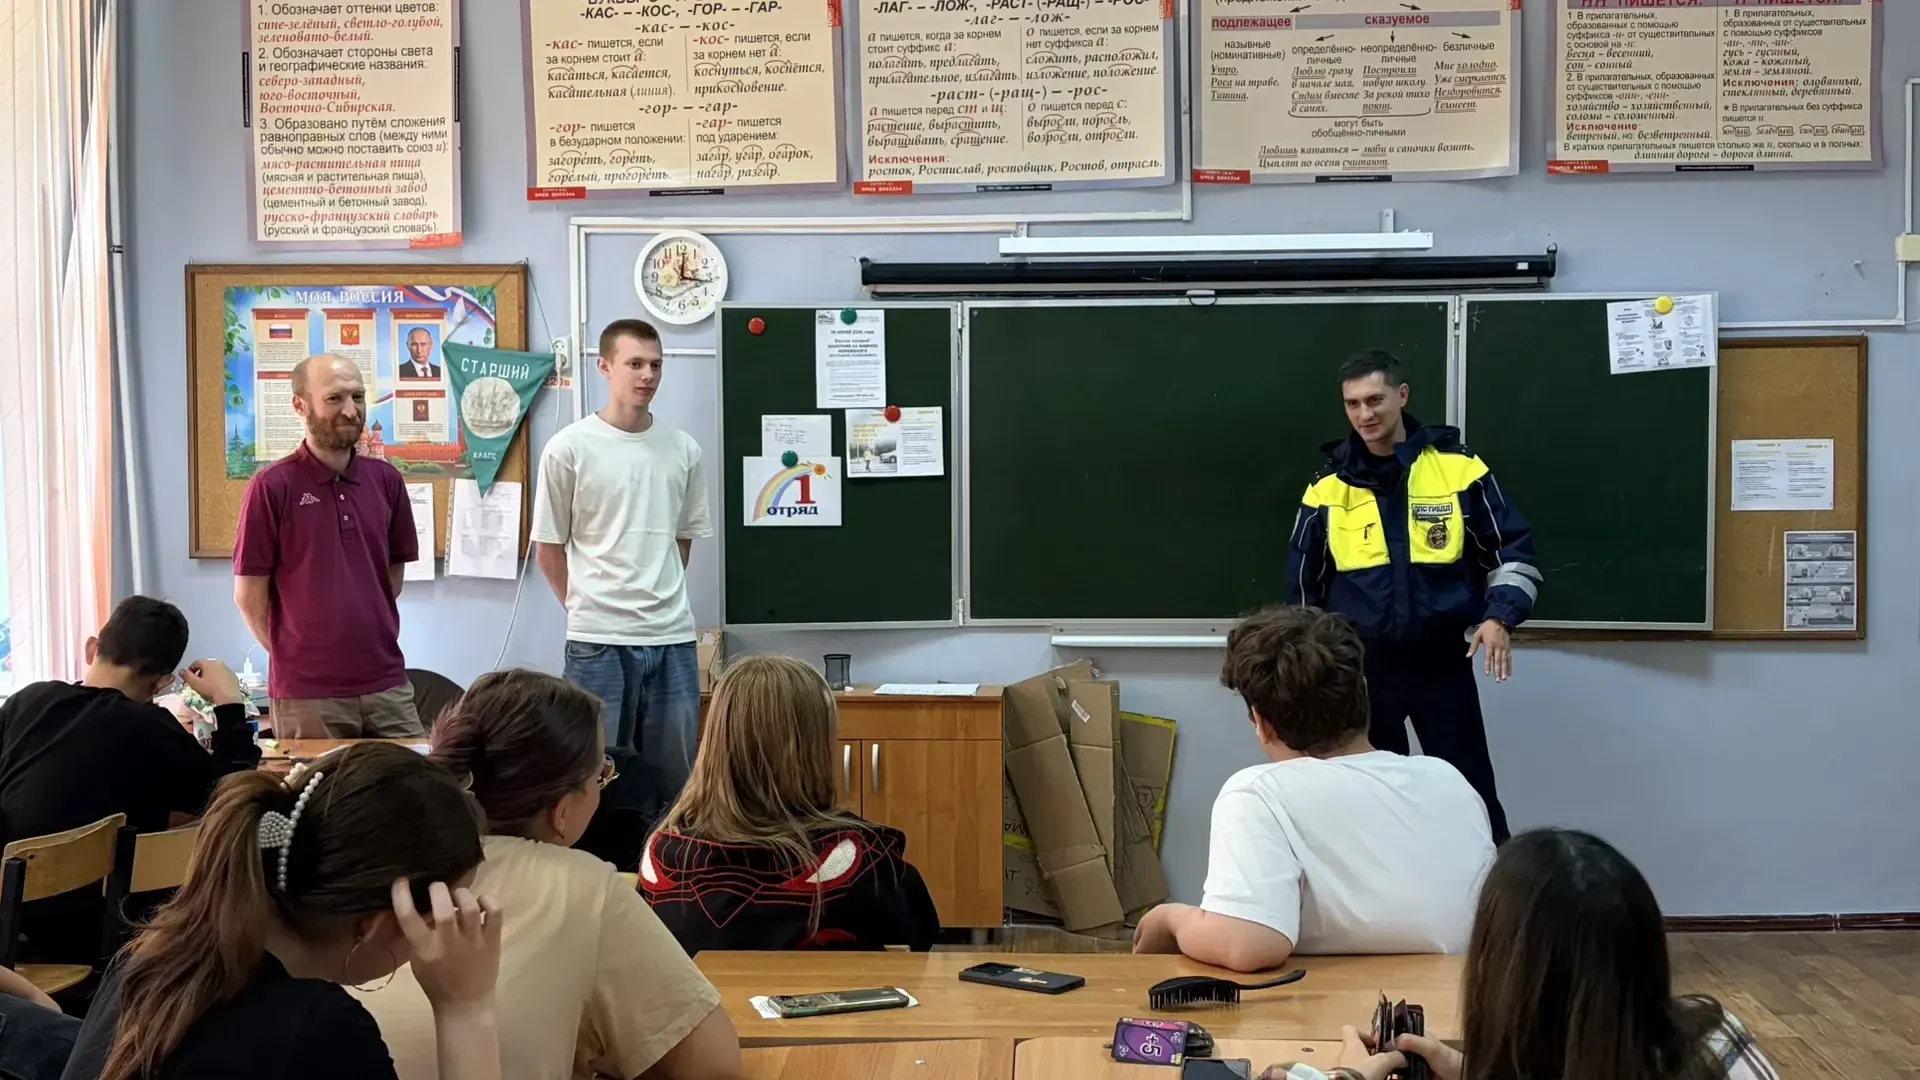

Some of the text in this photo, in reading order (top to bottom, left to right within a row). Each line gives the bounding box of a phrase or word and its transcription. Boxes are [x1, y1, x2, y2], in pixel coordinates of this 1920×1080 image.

[258, 3, 438, 16] 1. Обозначает оттенки цветов:
[580, 1, 782, 19] -КАС- -КОС-, -ГОР- -ГАР-
[874, 1, 912, 13] -ЛАГ-
[930, 0, 977, 12] -ЛОЖ-,
[965, 13, 1070, 25] -лаг- -лож-
[1211, 14, 1430, 31] подлежащее сказуемое
[635, 21, 735, 33] -кас- -кос-
[1026, 24, 1159, 37] о пишется, если за корнем
[693, 33, 811, 45] -кос- пишется, если
[868, 30, 1001, 42] а пишется, когда за корнем
[546, 38, 663, 49] -кас- пишется, если
[867, 42, 956, 55] стоит суффикс а:
[1026, 37, 1108, 50] нет суффикса а:
[1224, 40, 1271, 49] назывные
[1443, 41, 1495, 52] безличные
[258, 46, 433, 60] 2. Обозначает стороны света
[693, 49, 767, 61] за корнем нет
[1210, 49, 1285, 61] (номинативные)
[259, 59, 427, 74] и географические названия:
[546, 54, 631, 66] за корнем стоит
[639, 102, 738, 117] -гор- -гар-
[260, 117, 445, 131] 3. Образовано путём сложения
[549, 122, 635, 137] -гор- пишется
[696, 118, 782, 132] -гар- пишется
[1334, 118, 1384, 130] могут быть
[1566, 122, 1641, 131] Исключение:
[260, 130, 447, 145] равноправных слов (между ними
[550, 135, 685, 149] в безударном положении:
[696, 132, 779, 144] под ударением:
[261, 143, 304, 155] обычно
[307, 145, 344, 155] можно
[347, 145, 404, 154] поставить
[406, 143, 433, 153] союз
[869, 155, 949, 164] Исключения:
[295, 290, 405, 304] МОЯ РОССИЯ
[461, 357, 530, 380] СТАРШИЙ
[793, 474, 816, 504] 1
[767, 505, 819, 518] отряд
